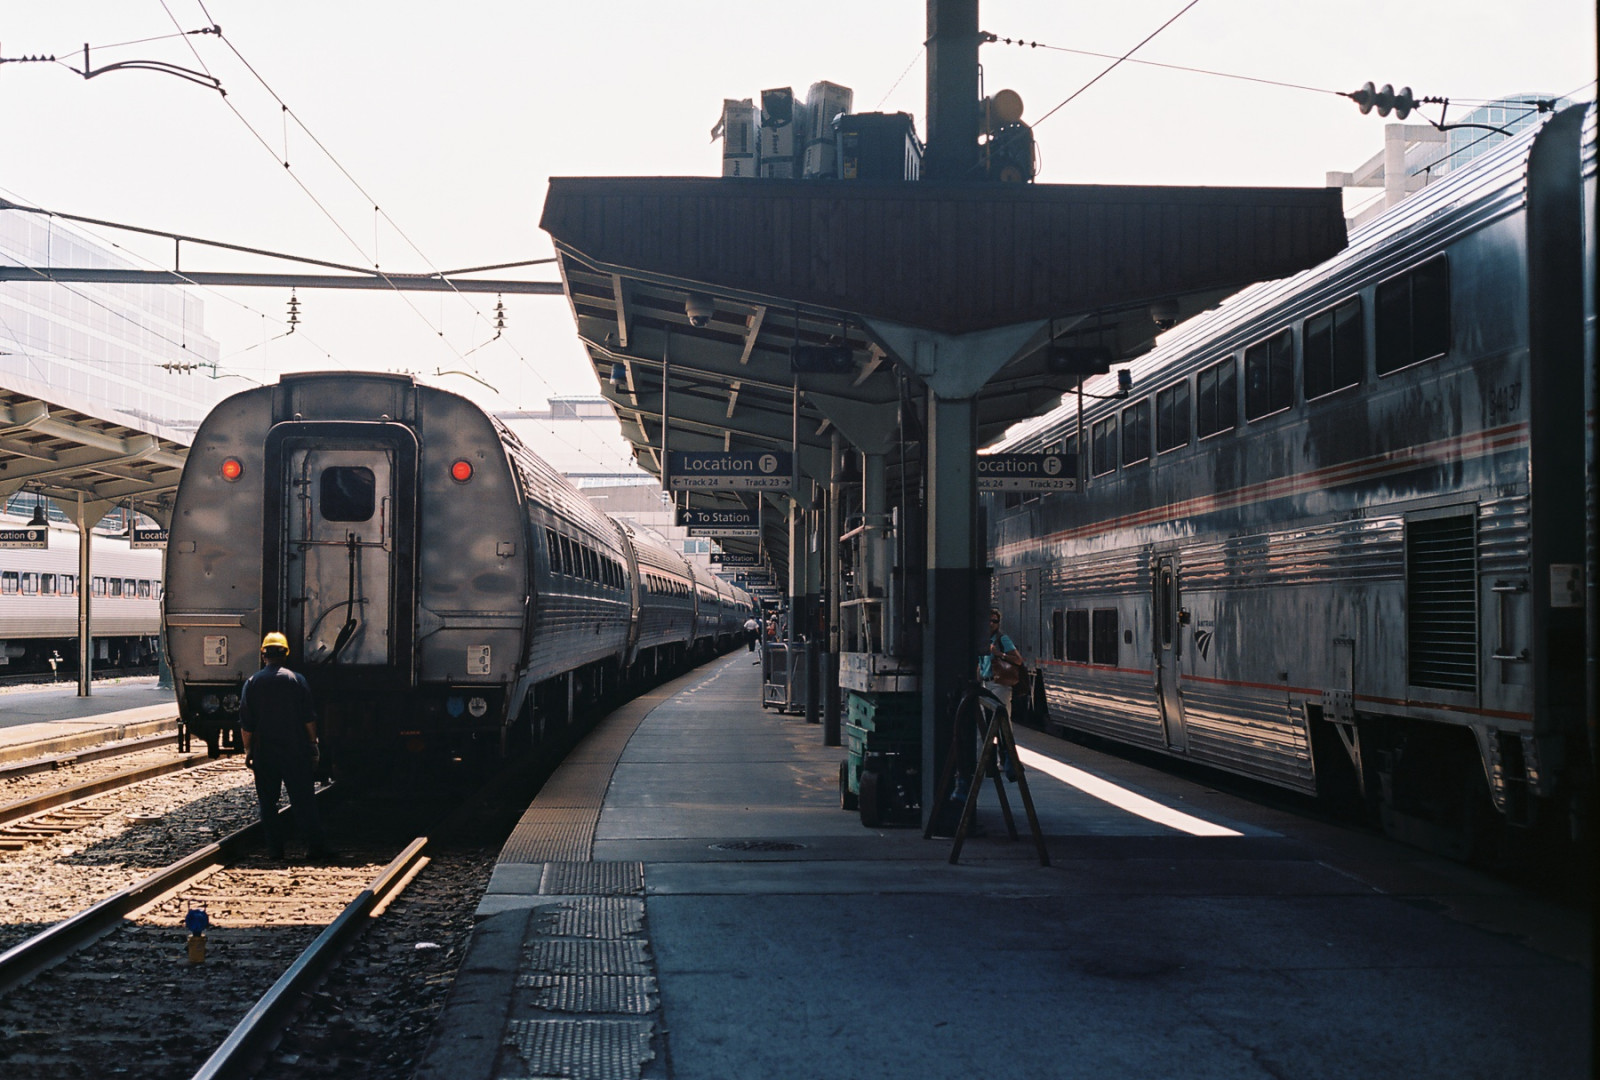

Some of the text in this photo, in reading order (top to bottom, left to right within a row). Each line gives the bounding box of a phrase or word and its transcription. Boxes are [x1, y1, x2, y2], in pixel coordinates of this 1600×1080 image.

[684, 456, 753, 471] Location
[977, 458, 1038, 472] ocation
[683, 478, 779, 486] Track 24 Track 23
[977, 480, 1064, 488] ack 24 Track 23
[697, 512, 750, 522] To Station
[0, 531, 25, 540] cation
